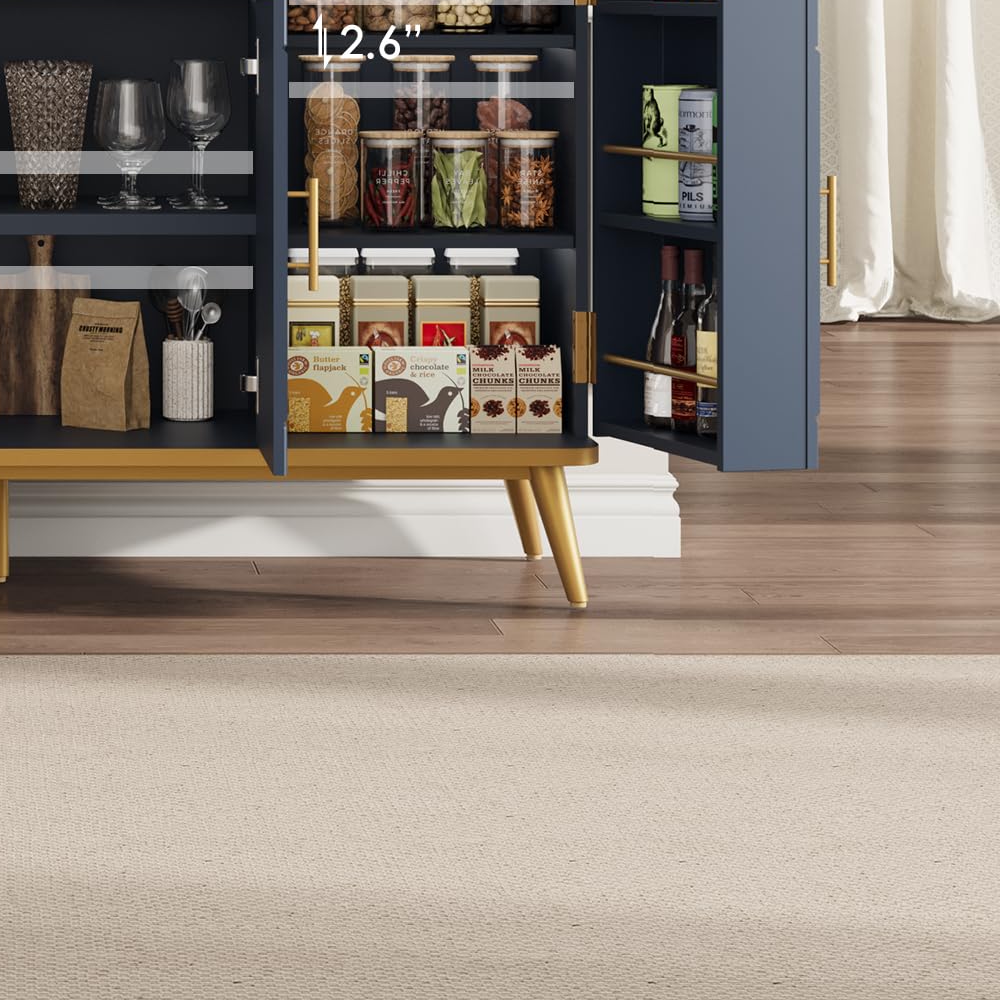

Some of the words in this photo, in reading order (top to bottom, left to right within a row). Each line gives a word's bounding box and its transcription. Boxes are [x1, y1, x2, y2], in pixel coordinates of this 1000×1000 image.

[681, 191, 704, 202] PILS
[312, 355, 341, 363] Butter
[410, 355, 437, 363] Crispy
[312, 364, 347, 373] flapjack
